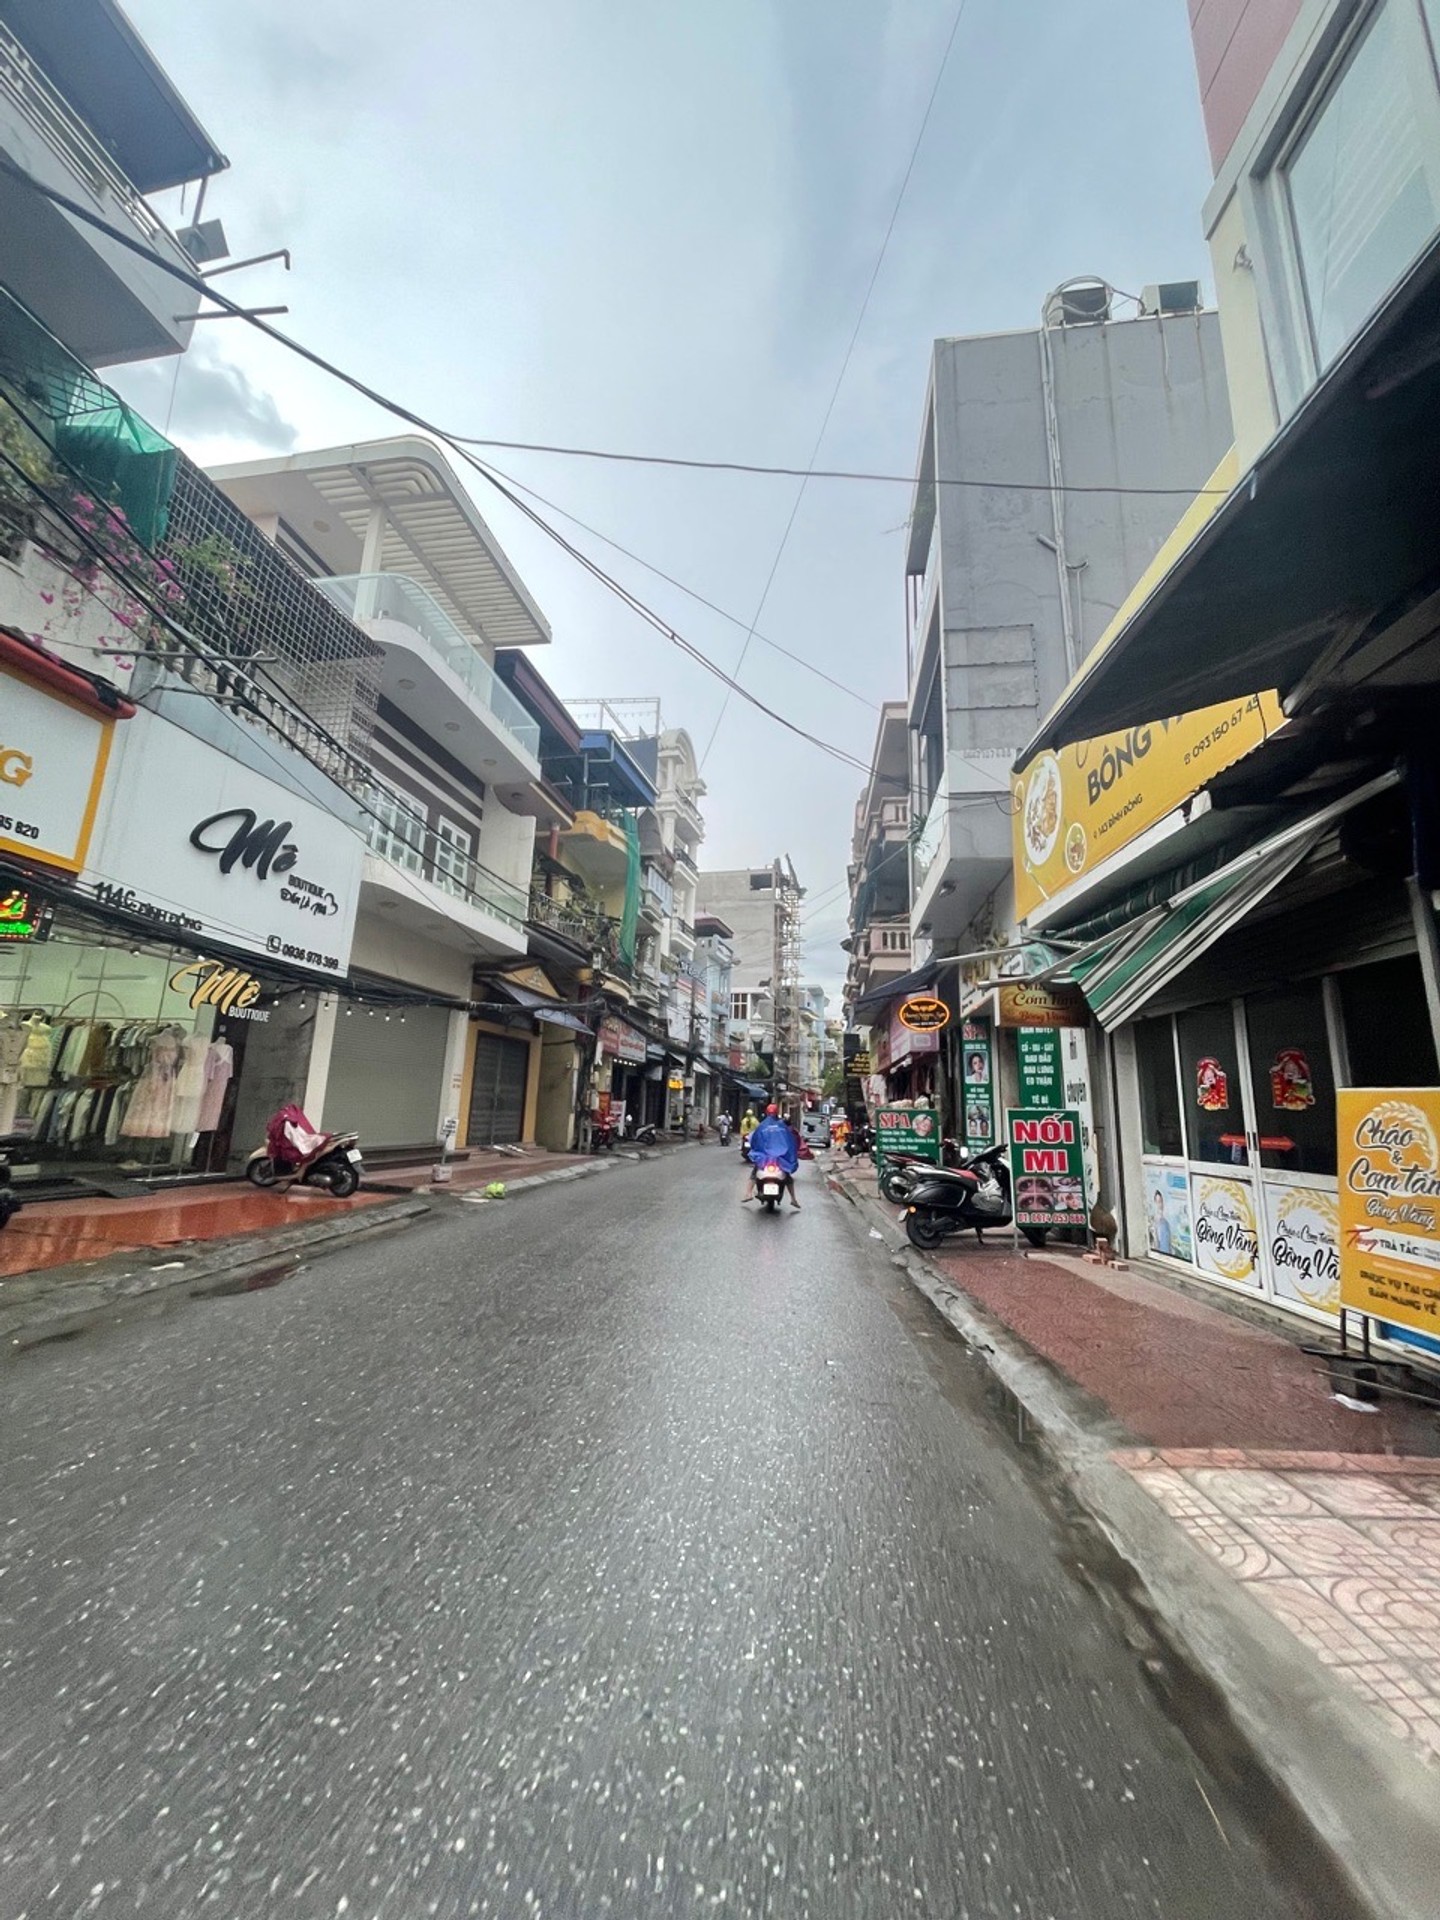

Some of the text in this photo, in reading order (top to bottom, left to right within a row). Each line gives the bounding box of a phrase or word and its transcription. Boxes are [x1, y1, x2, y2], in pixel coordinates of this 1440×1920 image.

[1192, 734, 1212, 758] 093
[1211, 720, 1230, 742] 150
[1231, 707, 1243, 727] 67
[1087, 727, 1152, 806] BÔNG
[15, 820, 40, 840] 820
[288, 874, 326, 899] BOUTIQUE
[228, 1005, 271, 1023] BOUTIQUE
[879, 1112, 911, 1129] SPA
[1012, 1112, 1075, 1145] NỐI
[1354, 1117, 1414, 1151] Cháo
[1022, 1148, 1069, 1174] MI
[1391, 1150, 1403, 1165] &
[1313, 1246, 1340, 1281] Và
